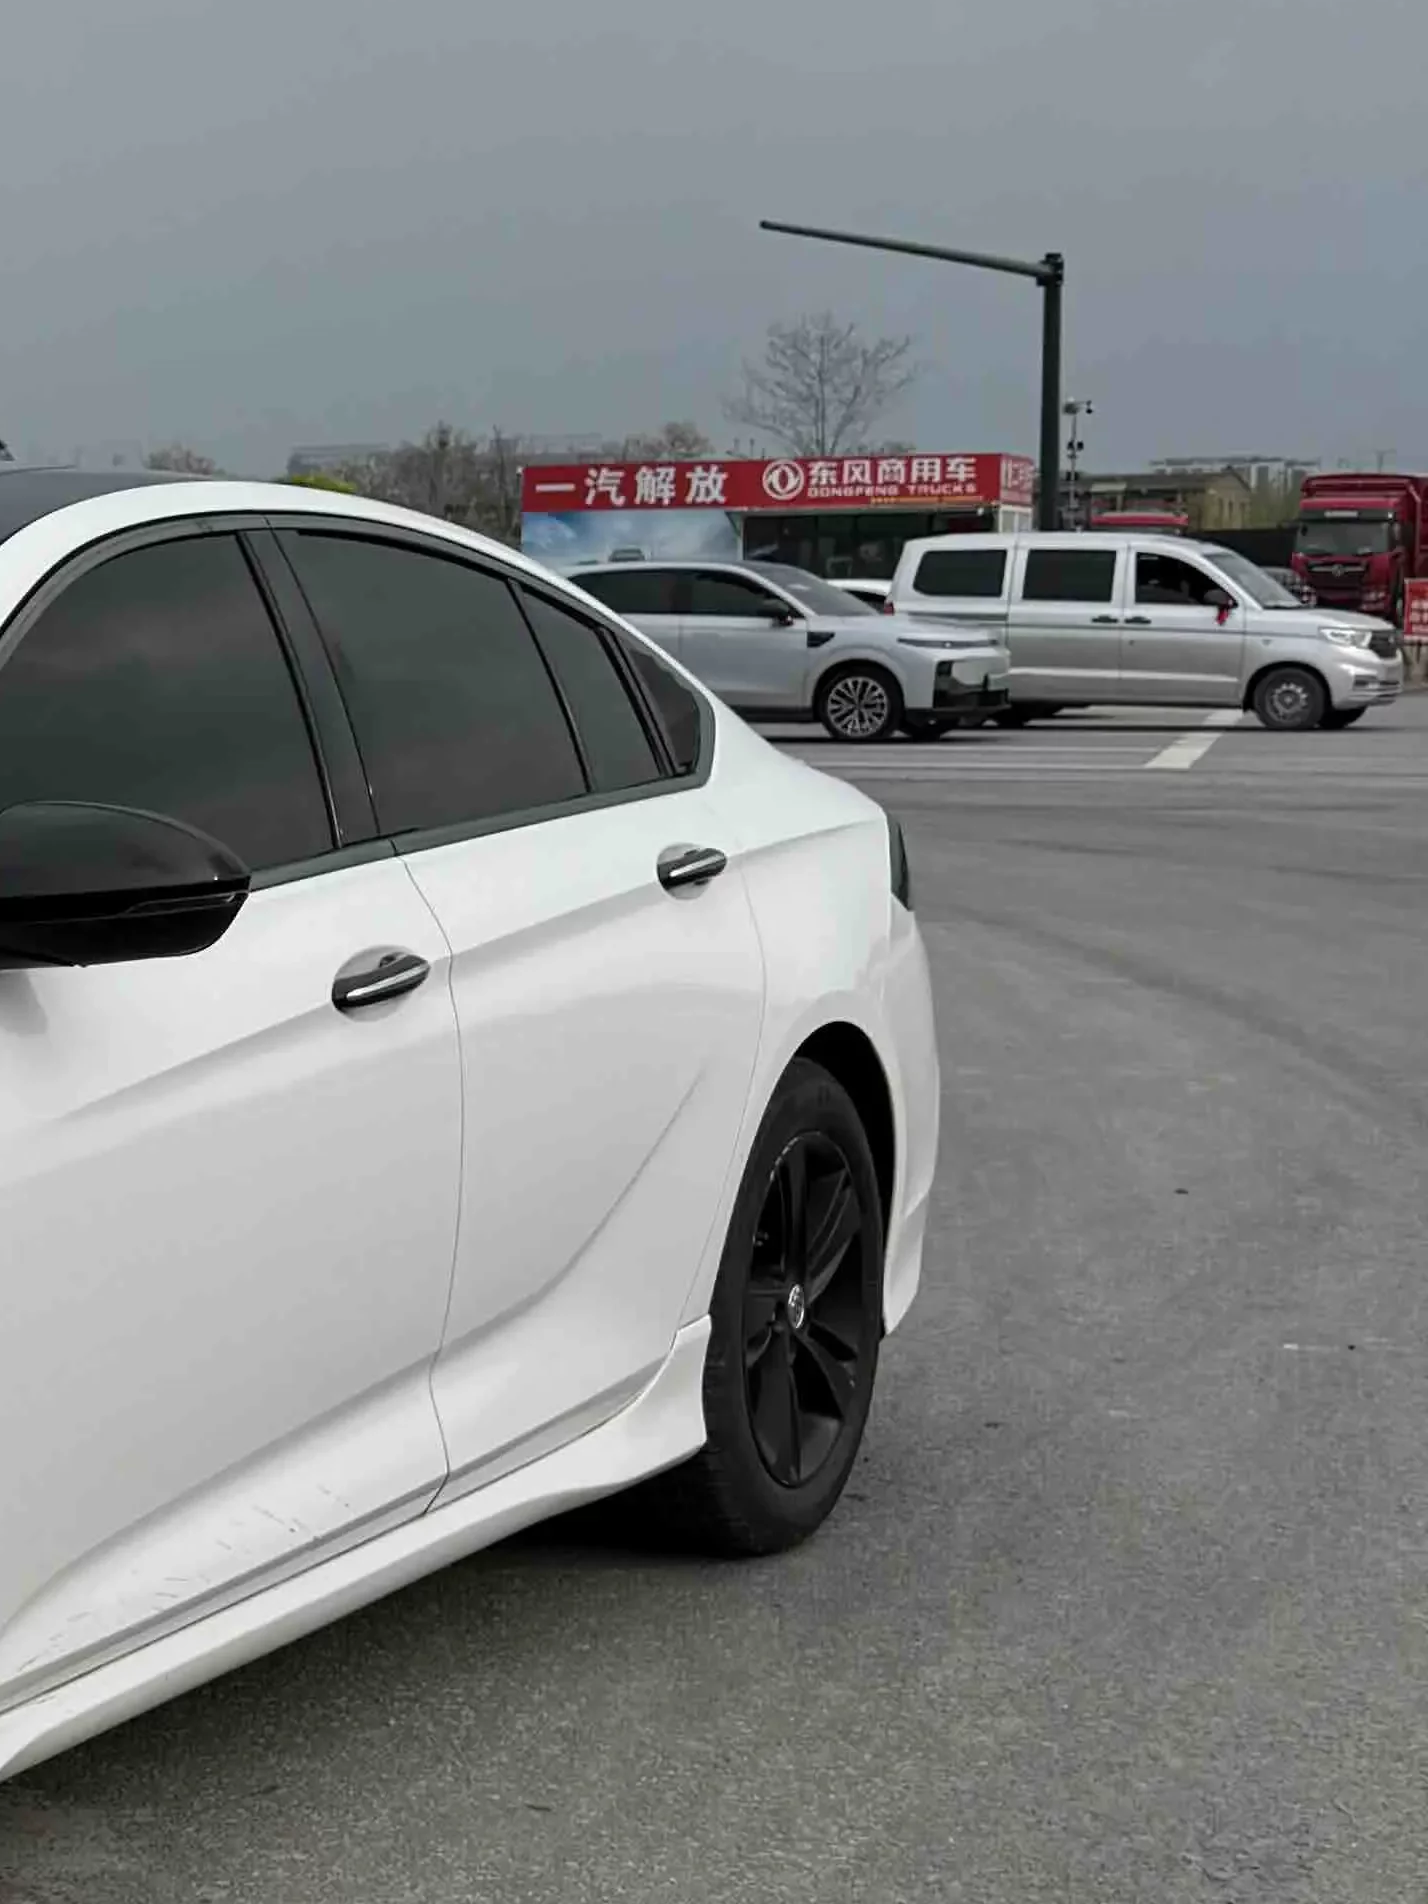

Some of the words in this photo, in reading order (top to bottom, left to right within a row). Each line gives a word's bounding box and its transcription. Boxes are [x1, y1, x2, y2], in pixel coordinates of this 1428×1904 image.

[808, 457, 977, 484] 东风商用车
[535, 465, 728, 506] 一汽解放
[907, 482, 977, 495] TRUCKS
